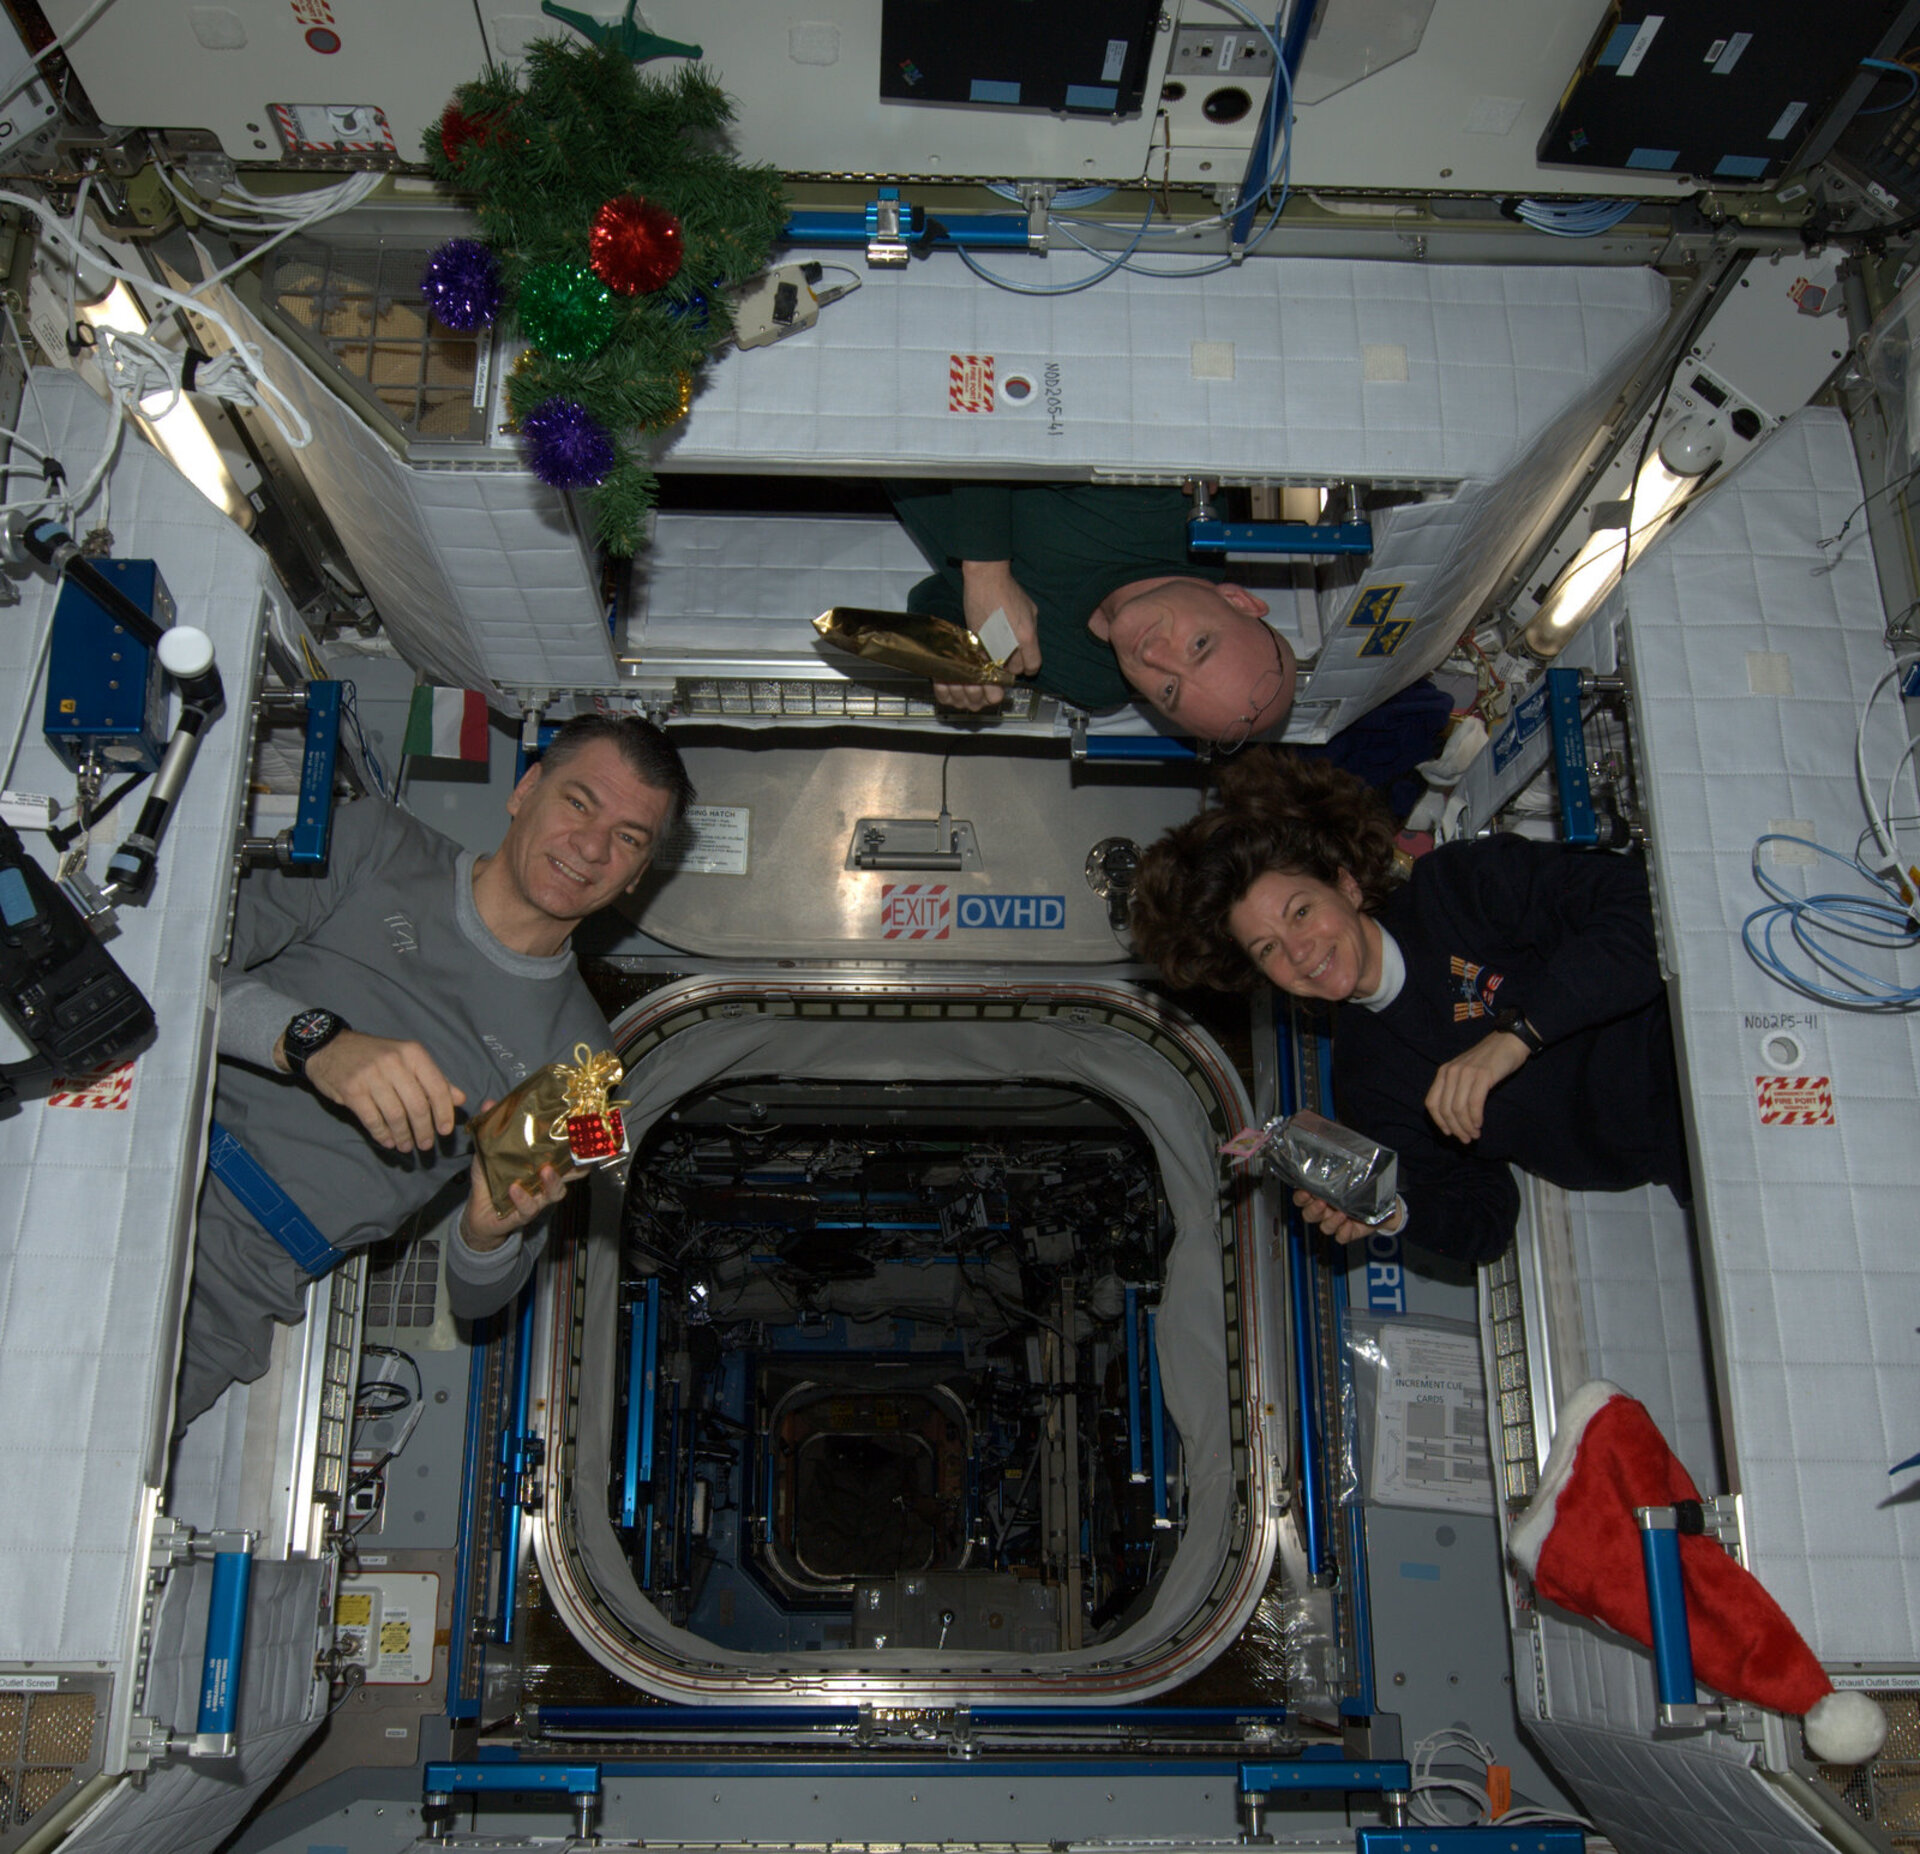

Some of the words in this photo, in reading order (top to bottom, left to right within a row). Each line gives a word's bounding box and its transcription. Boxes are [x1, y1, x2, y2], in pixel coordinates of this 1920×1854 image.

[479, 365, 488, 385] Outlet
[969, 366, 977, 381] FIRE
[476, 385, 485, 405] Screen
[969, 382, 977, 400] PORT
[891, 897, 939, 927] EXIT
[961, 898, 1063, 927] OVHD
[66, 1079, 86, 1088] FIRE
[88, 1079, 114, 1089] PORT
[1794, 1097, 1816, 1105] PORT
[1368, 1234, 1402, 1312] ORT
[1395, 1378, 1445, 1389] INCREMENT
[1446, 1380, 1463, 1390] CUE
[1416, 1394, 1444, 1404] CARDS
[0, 1679, 24, 1688] Outlet
[25, 1679, 55, 1688] Screen
[1832, 1679, 1864, 1687] Exhaust
[1865, 1679, 1890, 1687] Outlet
[1891, 1679, 1920, 1687] Screen
